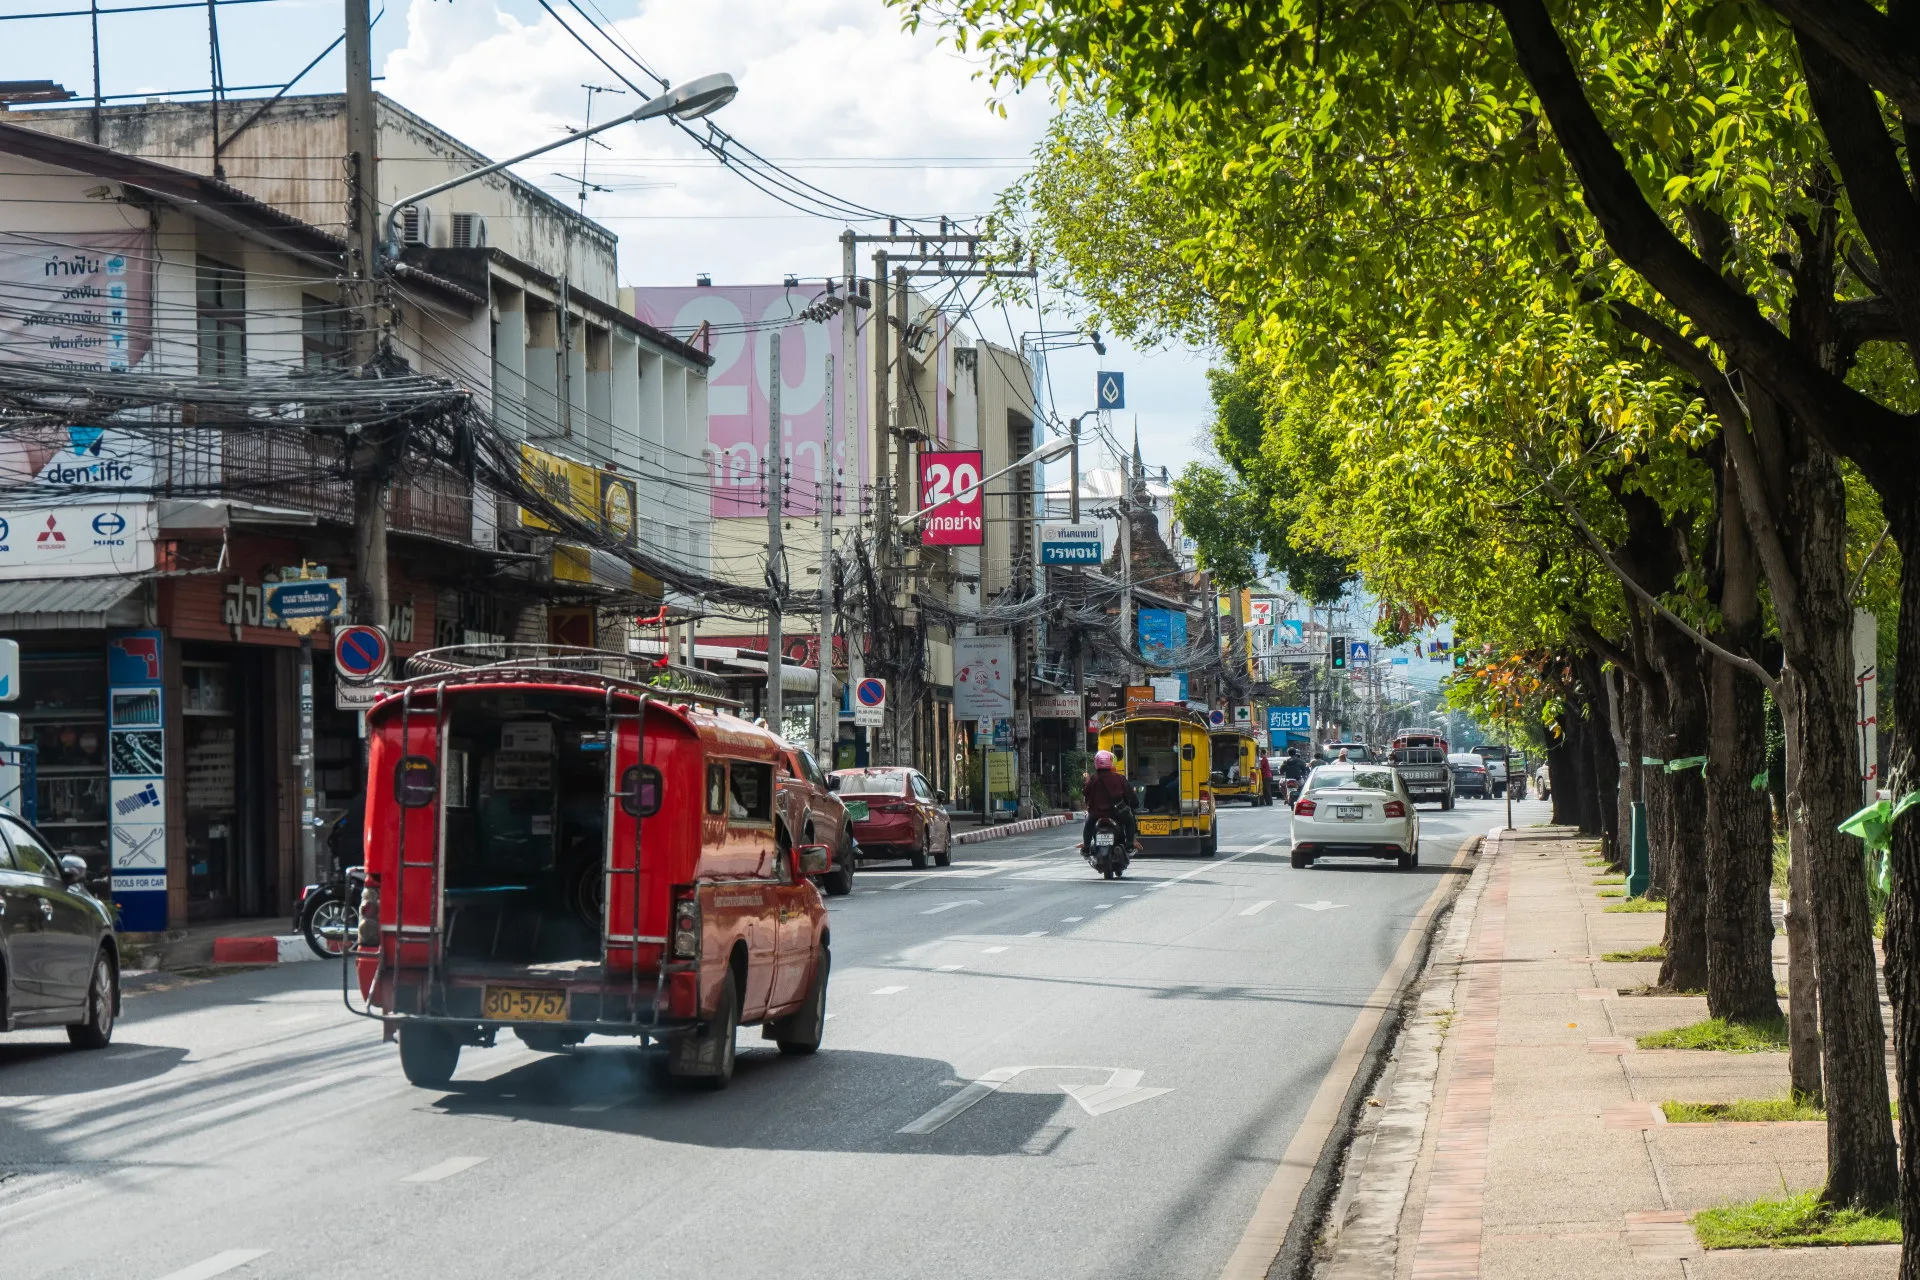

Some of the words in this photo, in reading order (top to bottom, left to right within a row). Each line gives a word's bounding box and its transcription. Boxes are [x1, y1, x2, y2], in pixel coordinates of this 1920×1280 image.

[45, 255, 100, 276] ทำฟัน
[672, 295, 832, 416] 20
[47, 462, 133, 484] dentific
[924, 463, 979, 504] 20
[1046, 543, 1098, 559] วรพจน์
[1291, 711, 1311, 727] ยา
[113, 879, 134, 888] TOOLS
[135, 879, 149, 887] FOR
[151, 878, 165, 887] CAR
[487, 990, 566, 1015] 30-5757
